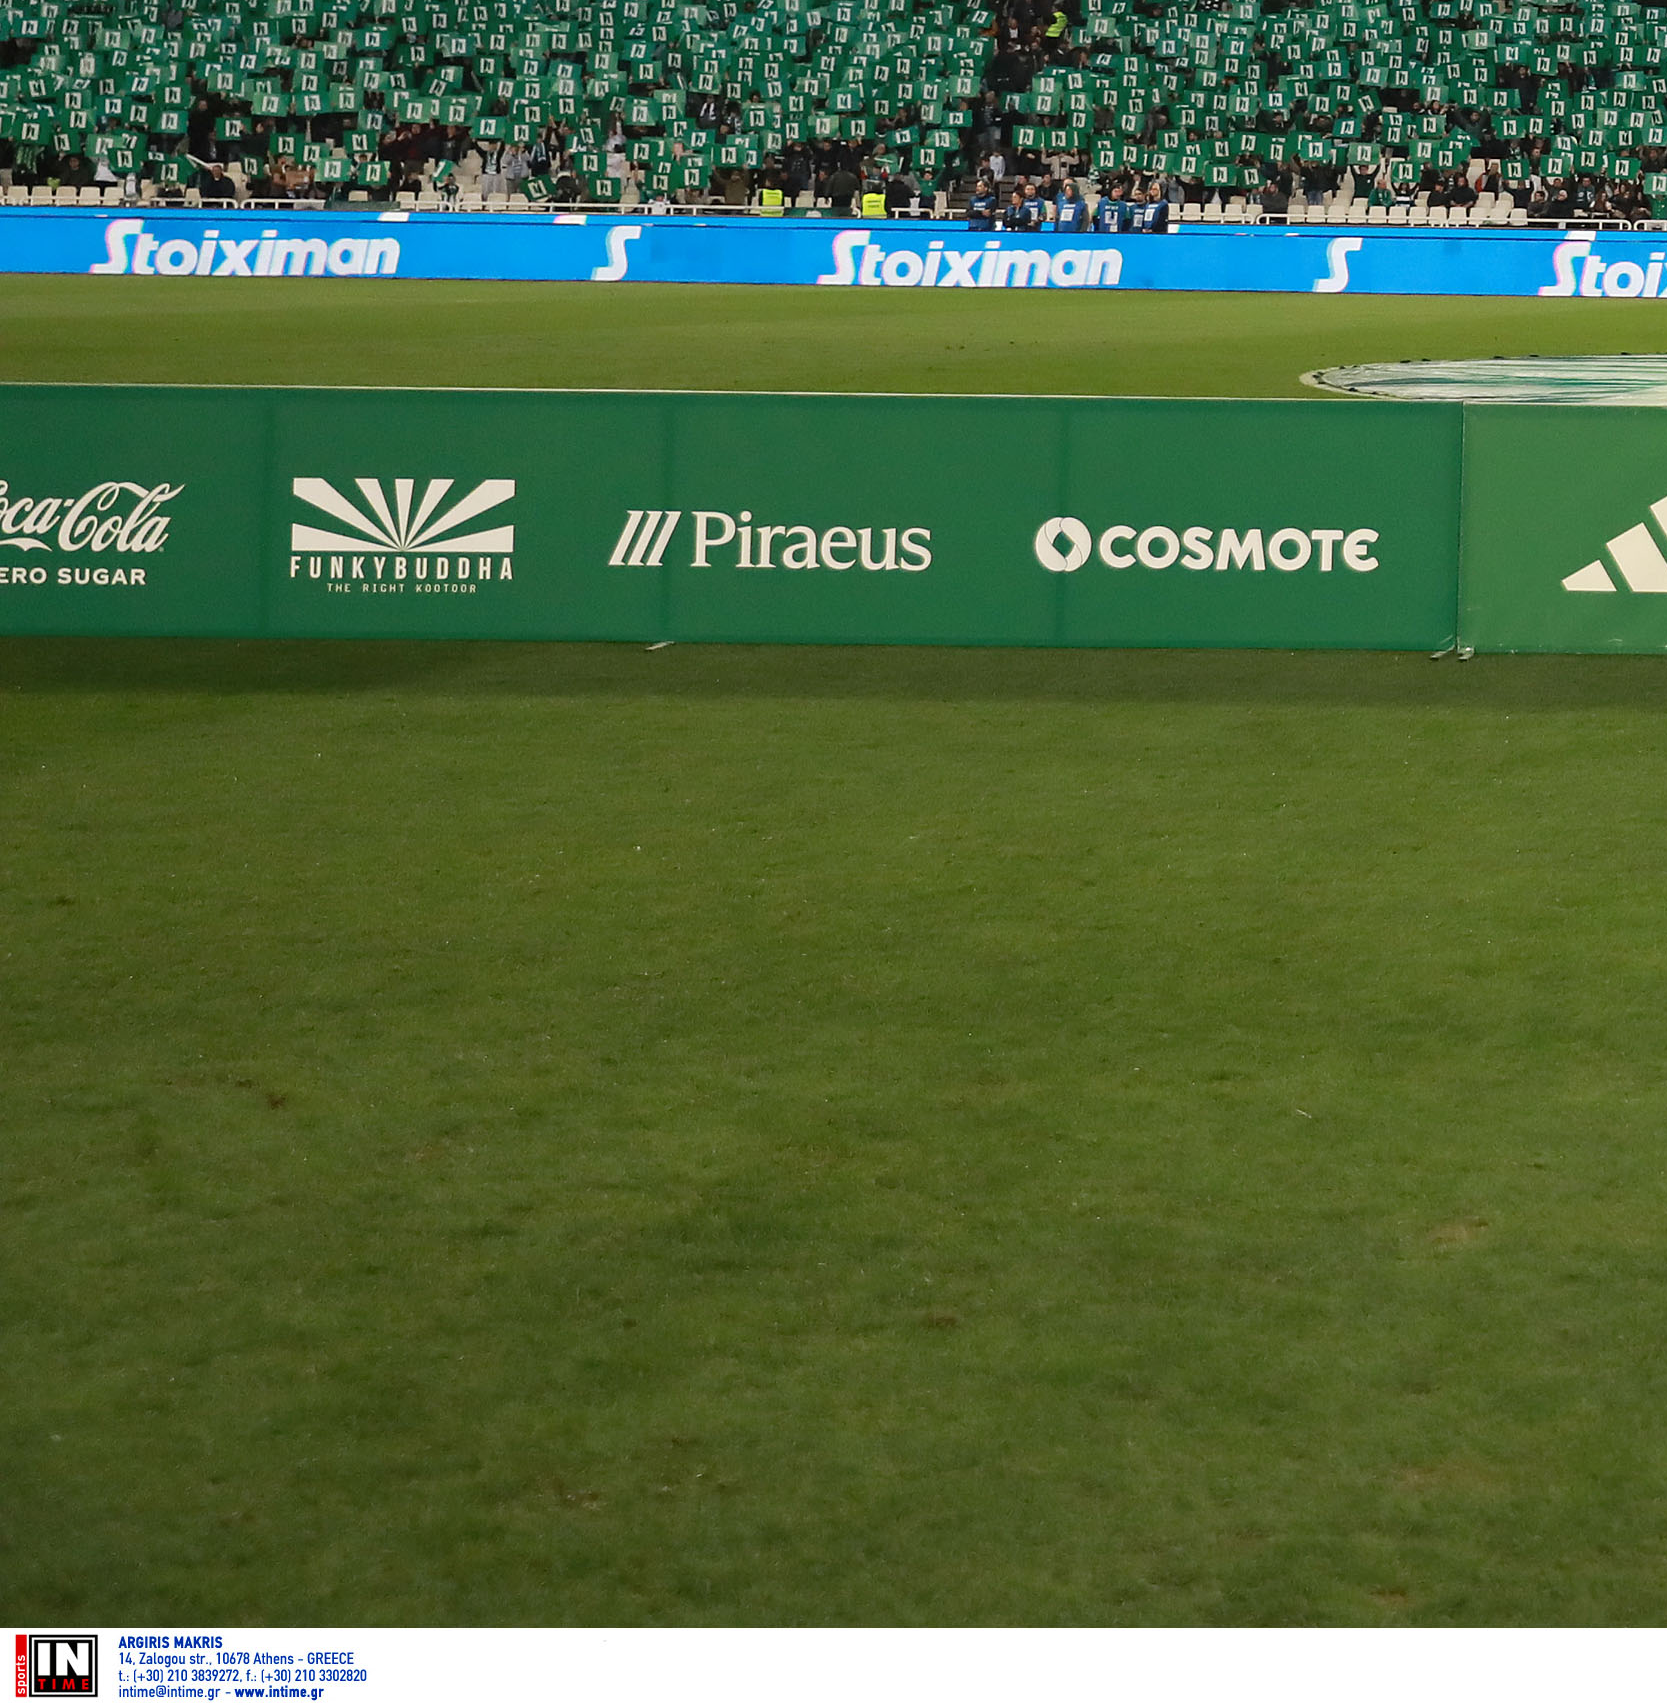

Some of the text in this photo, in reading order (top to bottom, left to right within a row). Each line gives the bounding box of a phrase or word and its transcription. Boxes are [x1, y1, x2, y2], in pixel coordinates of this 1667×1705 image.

[90, 219, 399, 276] Stoiximan
[816, 230, 1123, 288] Stoiximan
[691, 510, 932, 572] Piraeus
[1099, 524, 1380, 572] COSMOTE
[57, 567, 146, 585] SUGAR
[327, 583, 477, 593] THE RIGHT KOOTOOR
